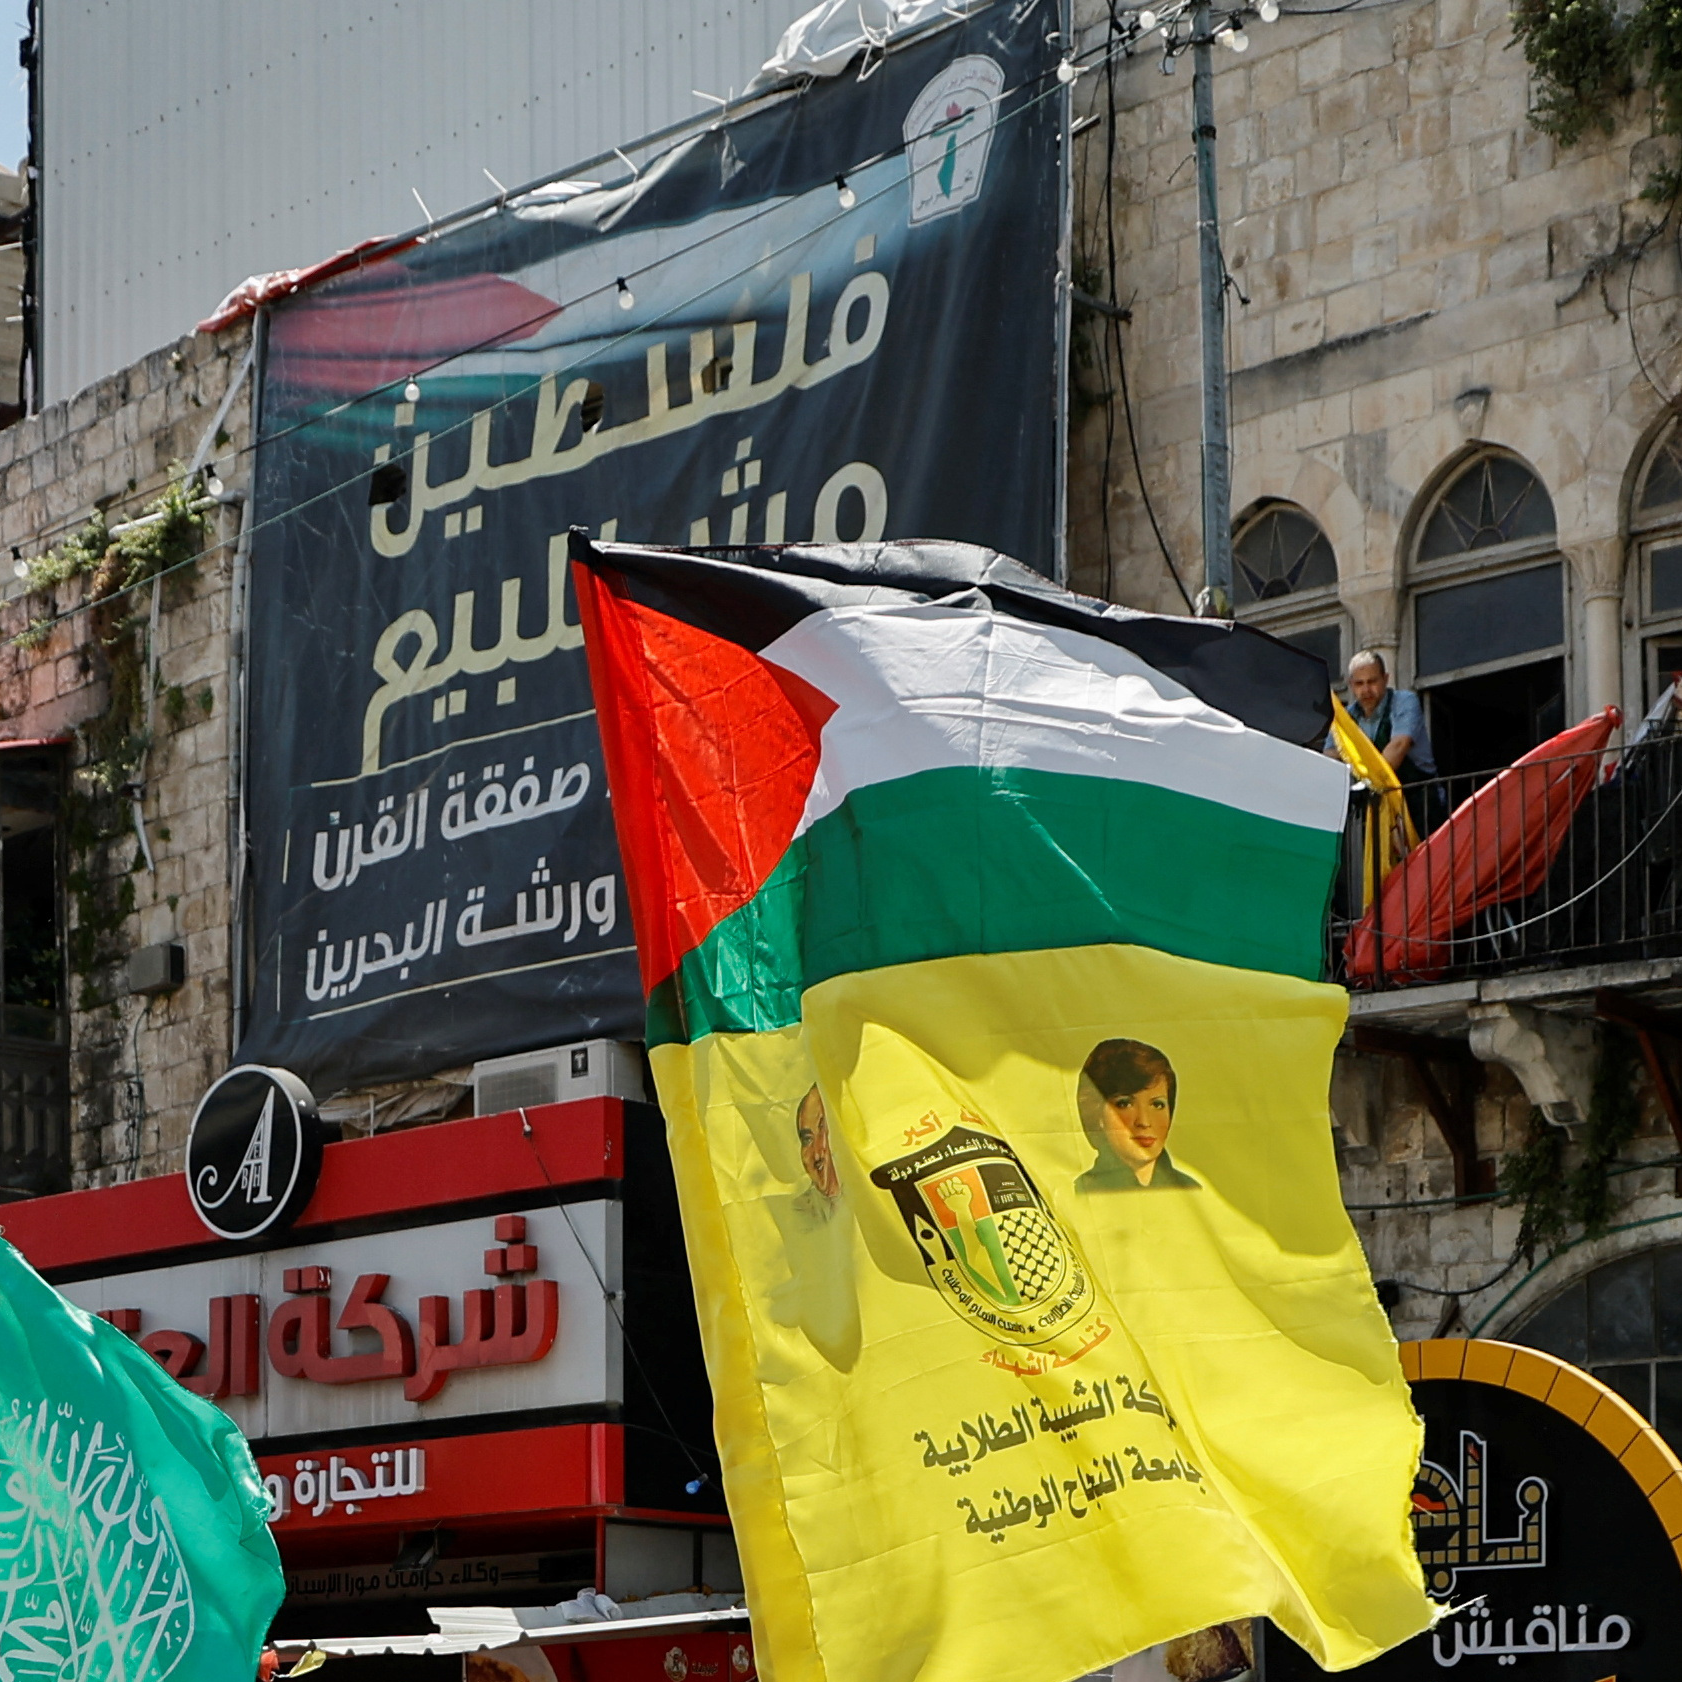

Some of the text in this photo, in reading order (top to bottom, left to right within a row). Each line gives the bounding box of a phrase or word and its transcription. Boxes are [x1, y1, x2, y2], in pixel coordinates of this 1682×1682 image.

[367, 234, 891, 558] فلسطين
[313, 754, 590, 892] صفقة القرن
[305, 857, 617, 1003] ورشة البحرين
[269, 1214, 559, 1402] شركة
[294, 1448, 425, 1518] للتجارة
[913, 1374, 1177, 1477] ركة الشبيبة الطلابية
[956, 1445, 1207, 1544] جامعة النجاح الوطنية
[1433, 1597, 1631, 1668] مناقيش
